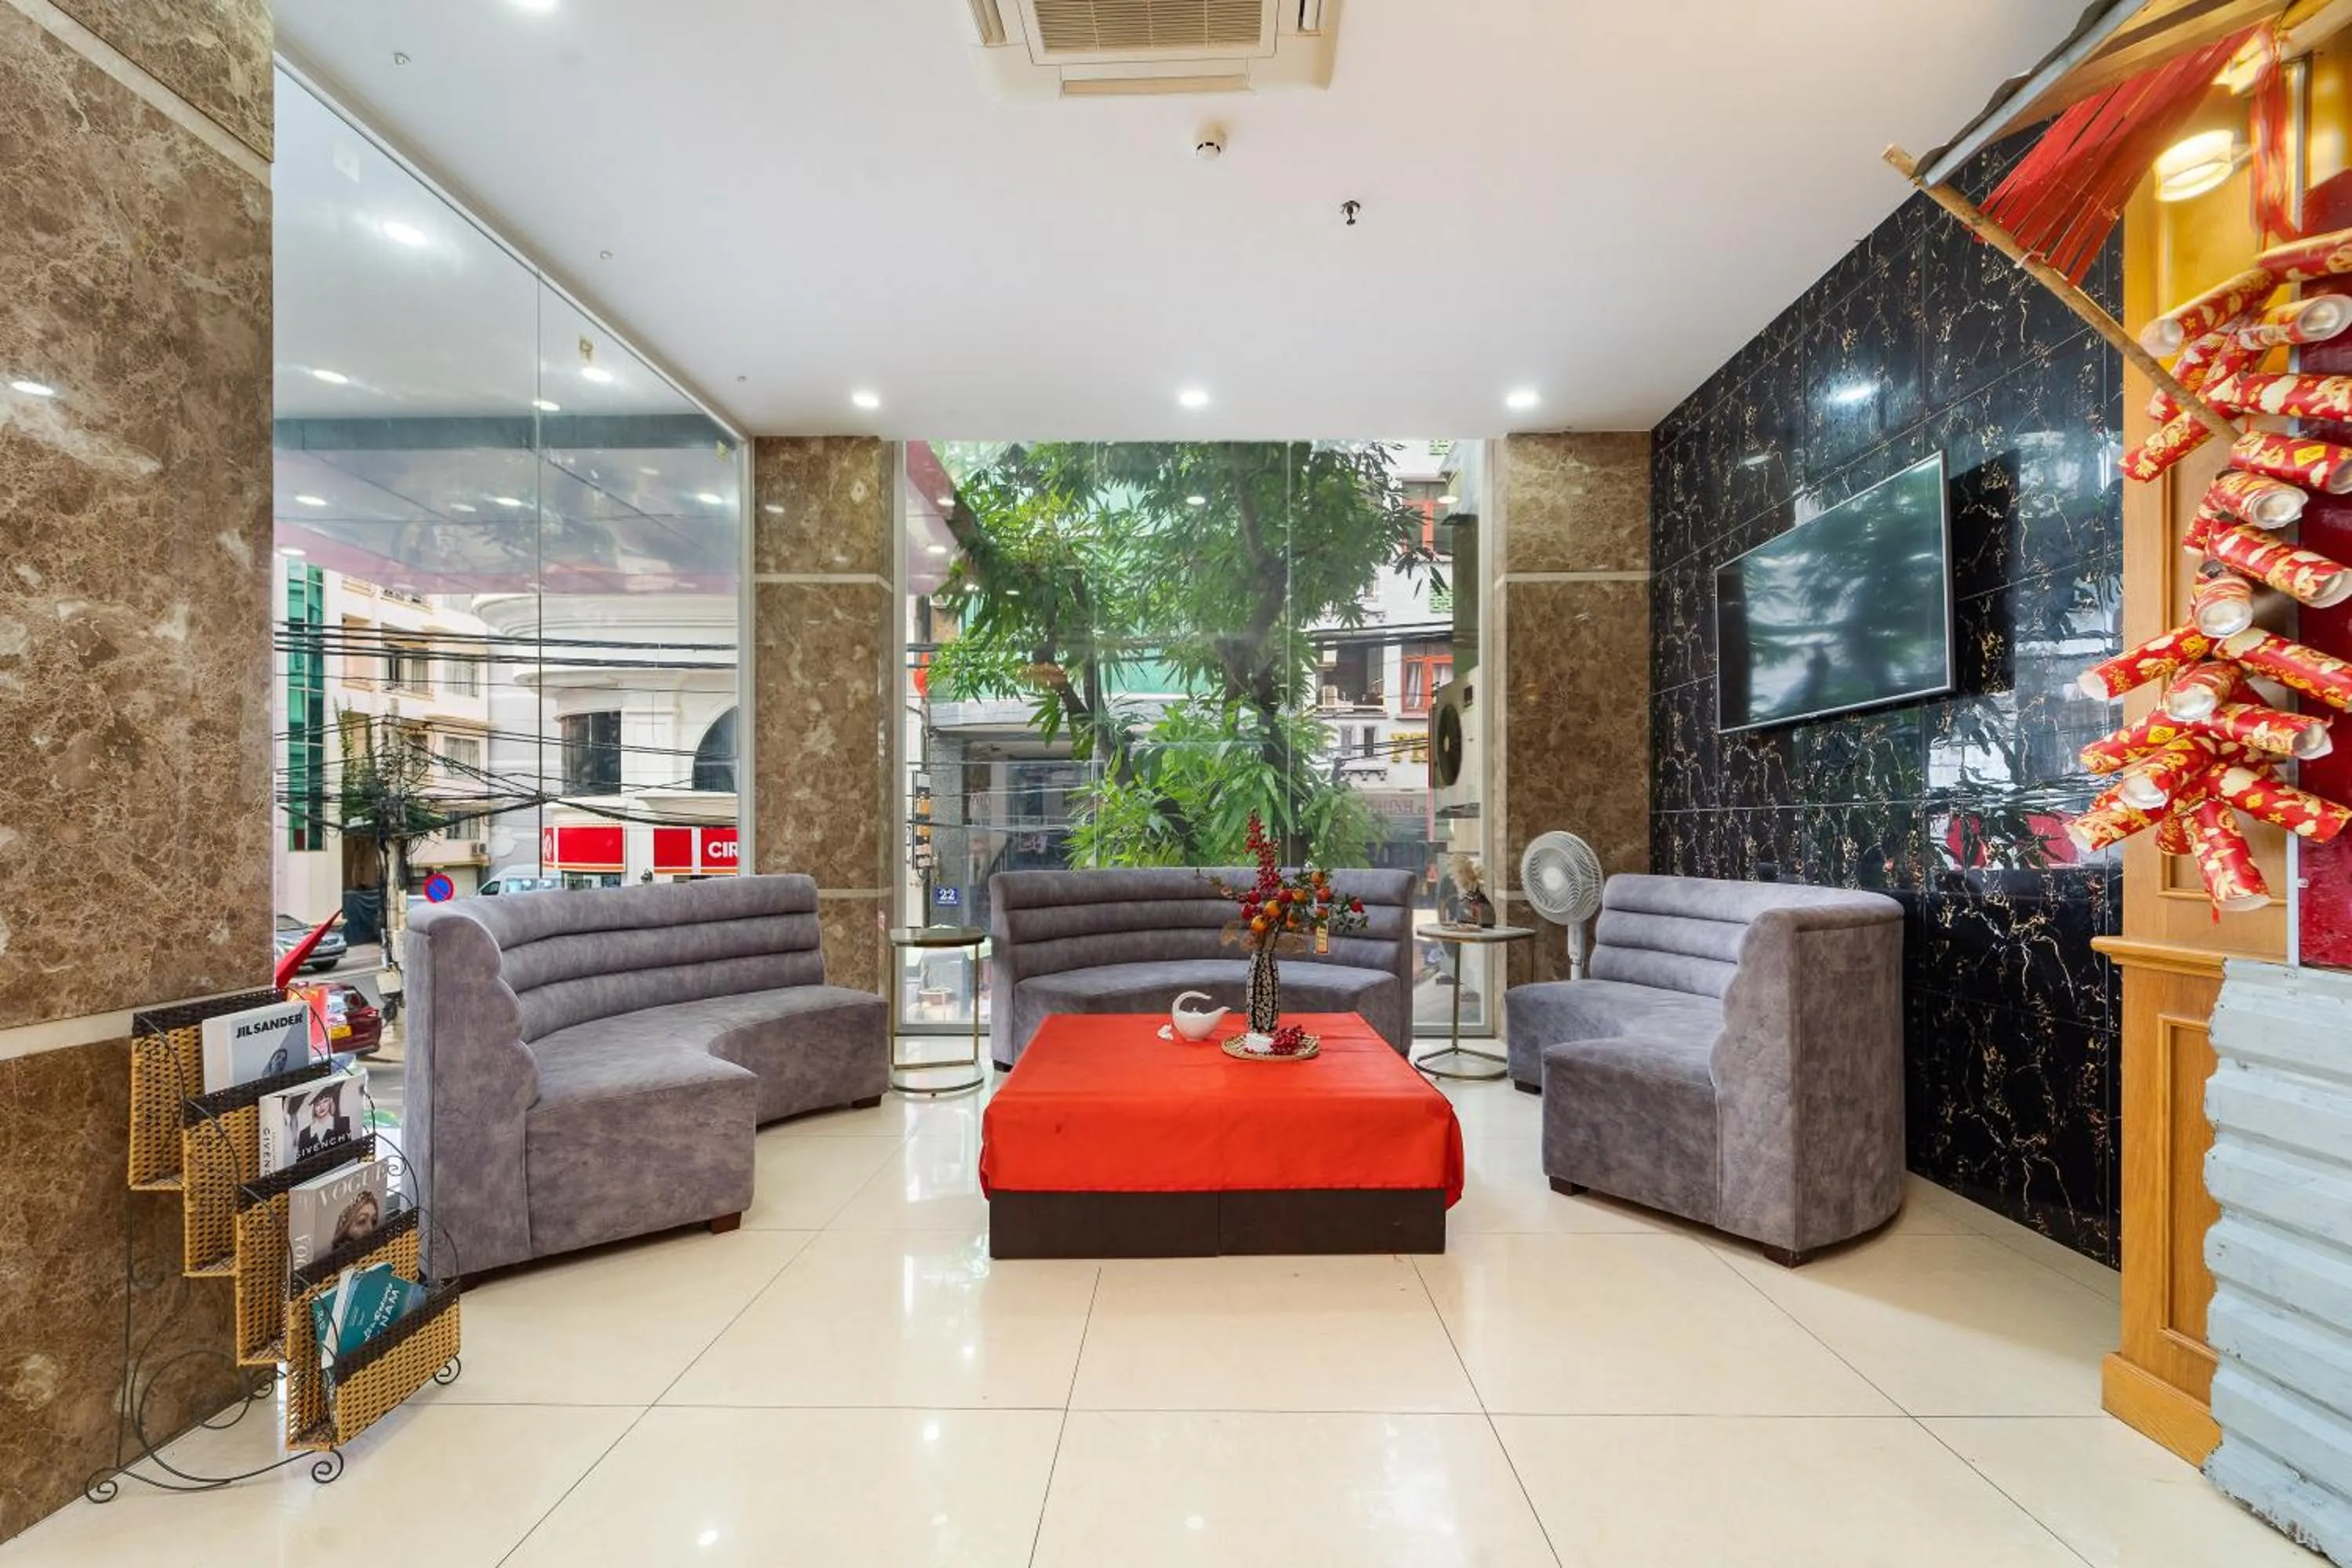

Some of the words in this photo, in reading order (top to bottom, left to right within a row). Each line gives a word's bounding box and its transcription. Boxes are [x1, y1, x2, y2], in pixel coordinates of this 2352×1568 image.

[708, 841, 739, 858] CIR
[939, 888, 956, 900] 22
[236, 1026, 252, 1039] JIL
[253, 1012, 303, 1034] SANDER
